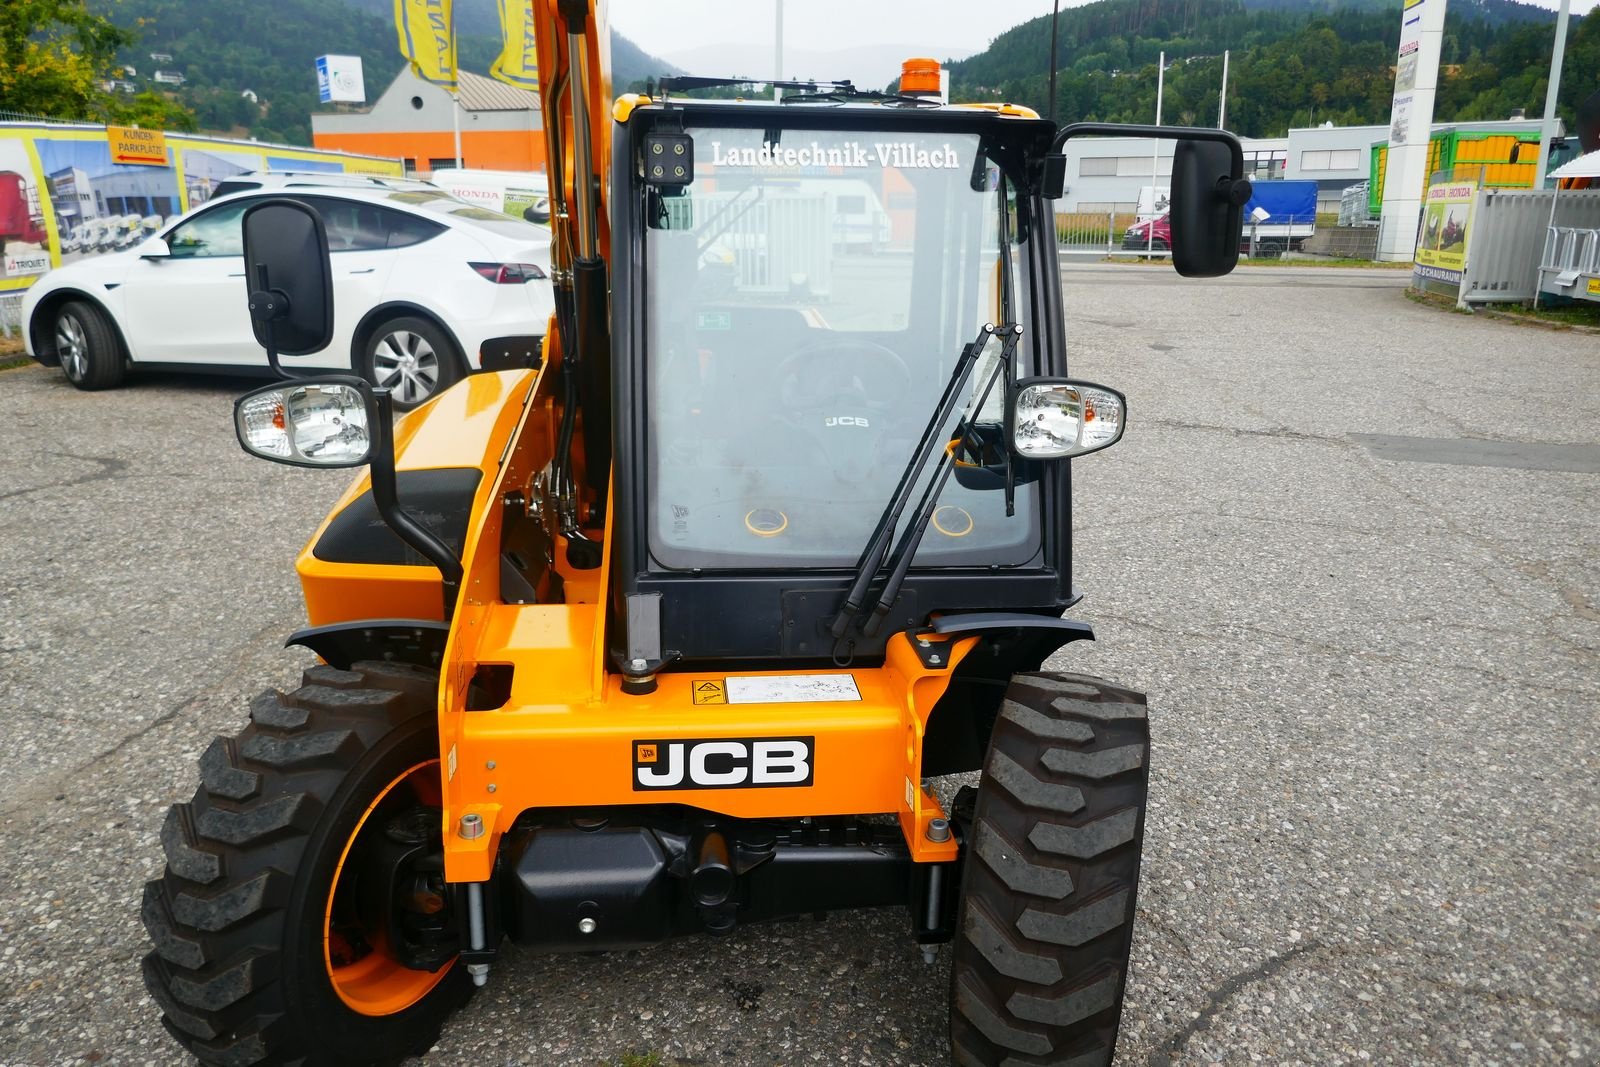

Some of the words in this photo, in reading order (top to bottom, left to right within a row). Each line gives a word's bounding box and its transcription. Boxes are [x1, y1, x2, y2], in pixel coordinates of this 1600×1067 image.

[712, 142, 959, 168] Landtechnik-Villach
[452, 188, 500, 200] HONDA
[1448, 187, 1471, 198] HONDA
[1422, 267, 1460, 283] SCHAURAUM
[826, 416, 870, 428] JCB
[637, 741, 810, 787] JCB
